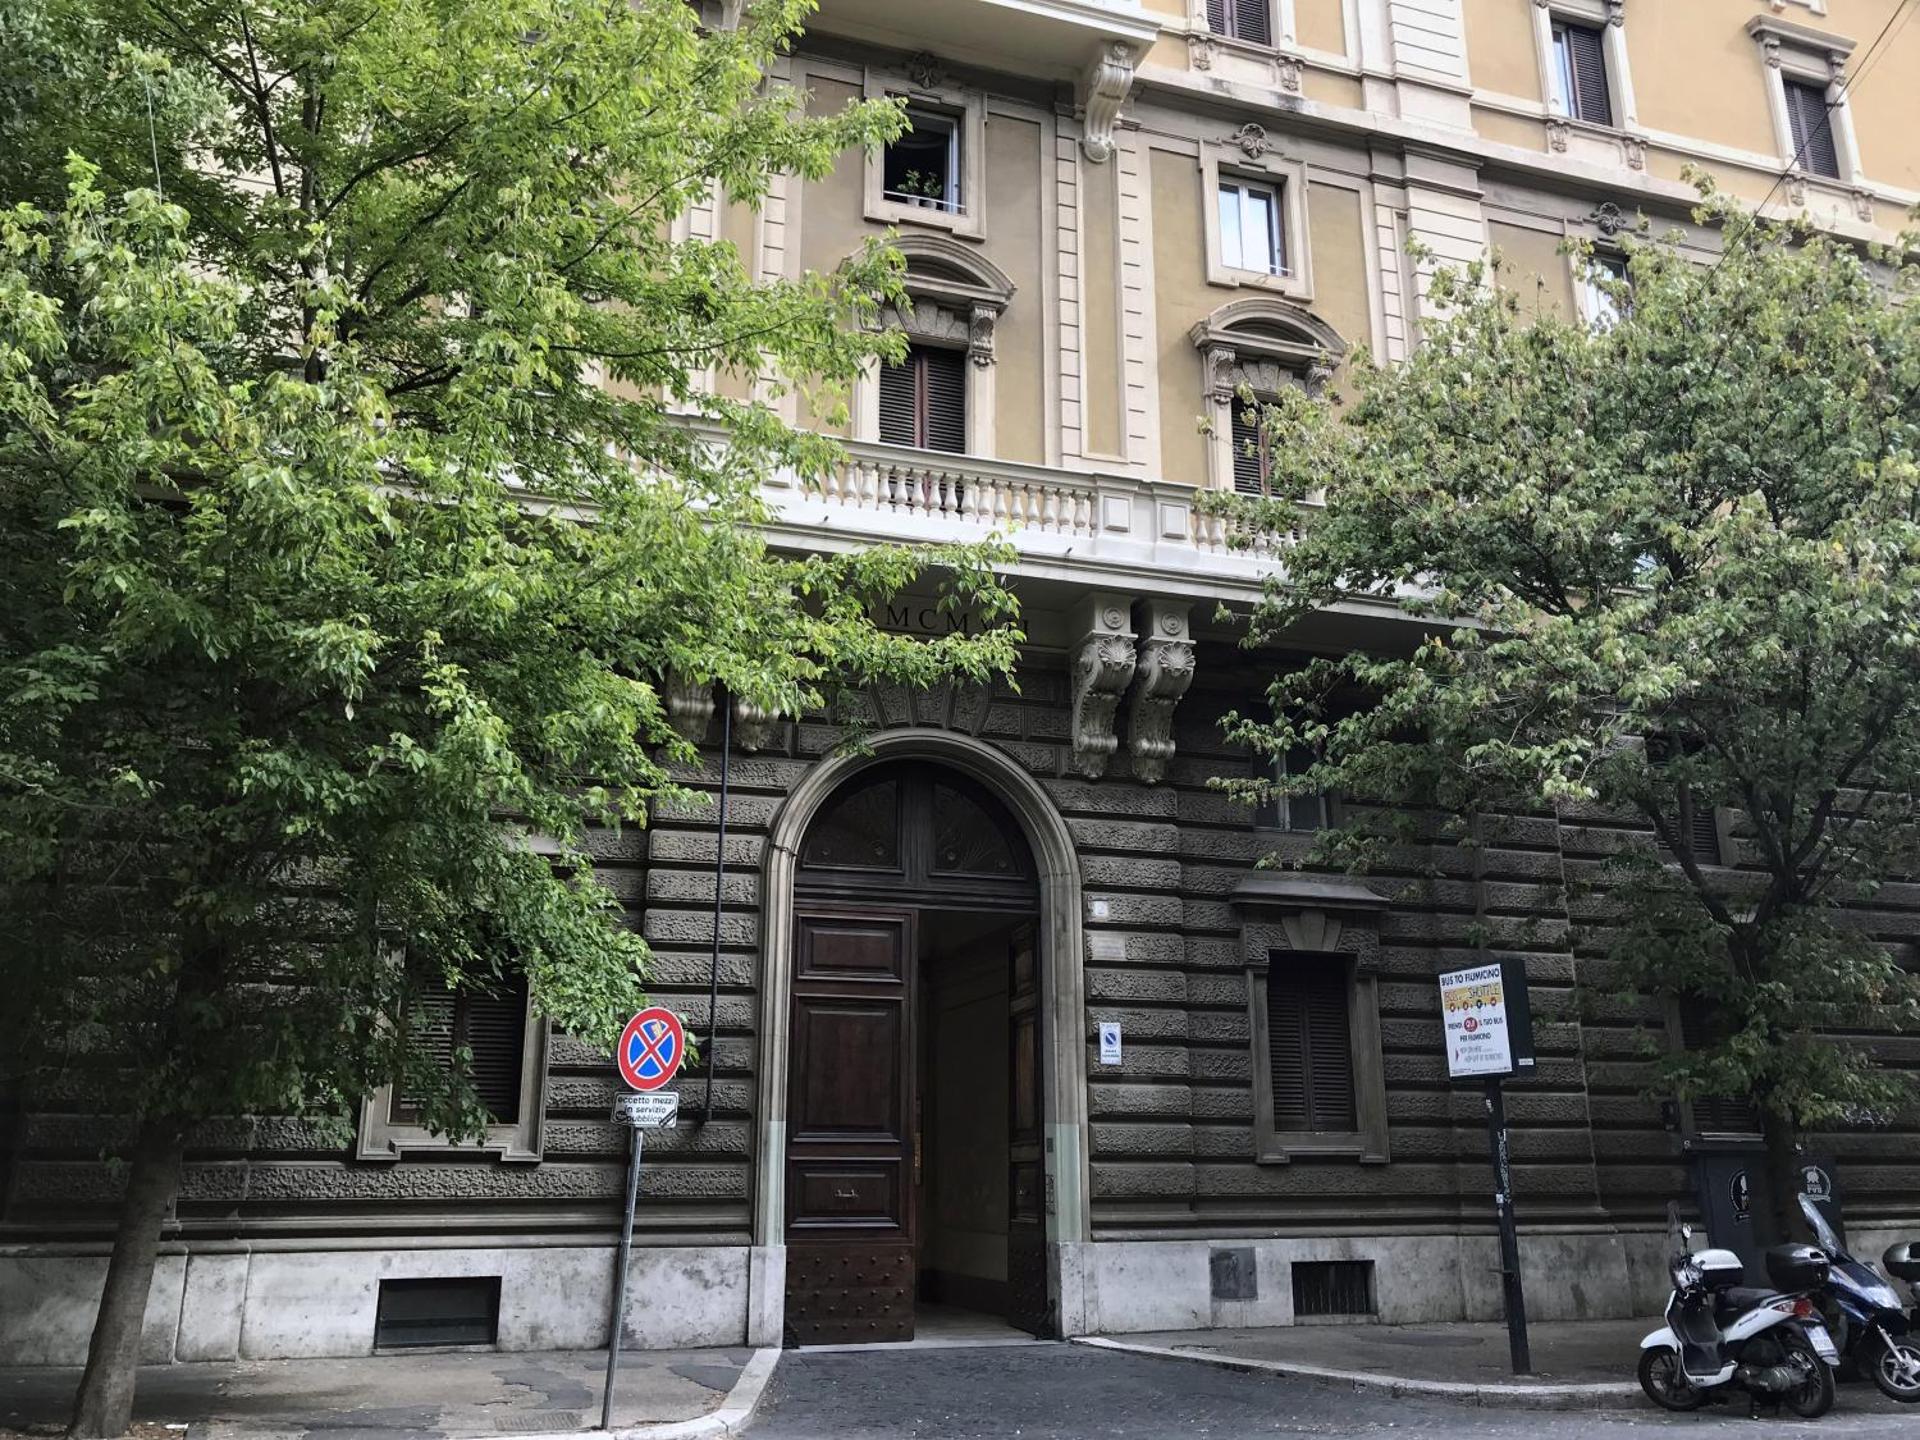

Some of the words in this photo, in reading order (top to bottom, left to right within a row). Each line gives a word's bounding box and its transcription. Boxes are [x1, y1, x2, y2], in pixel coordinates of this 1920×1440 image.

[1441, 975, 1455, 987] BUS
[1455, 973, 1464, 984] TO
[627, 1115, 663, 1123] pubblico
